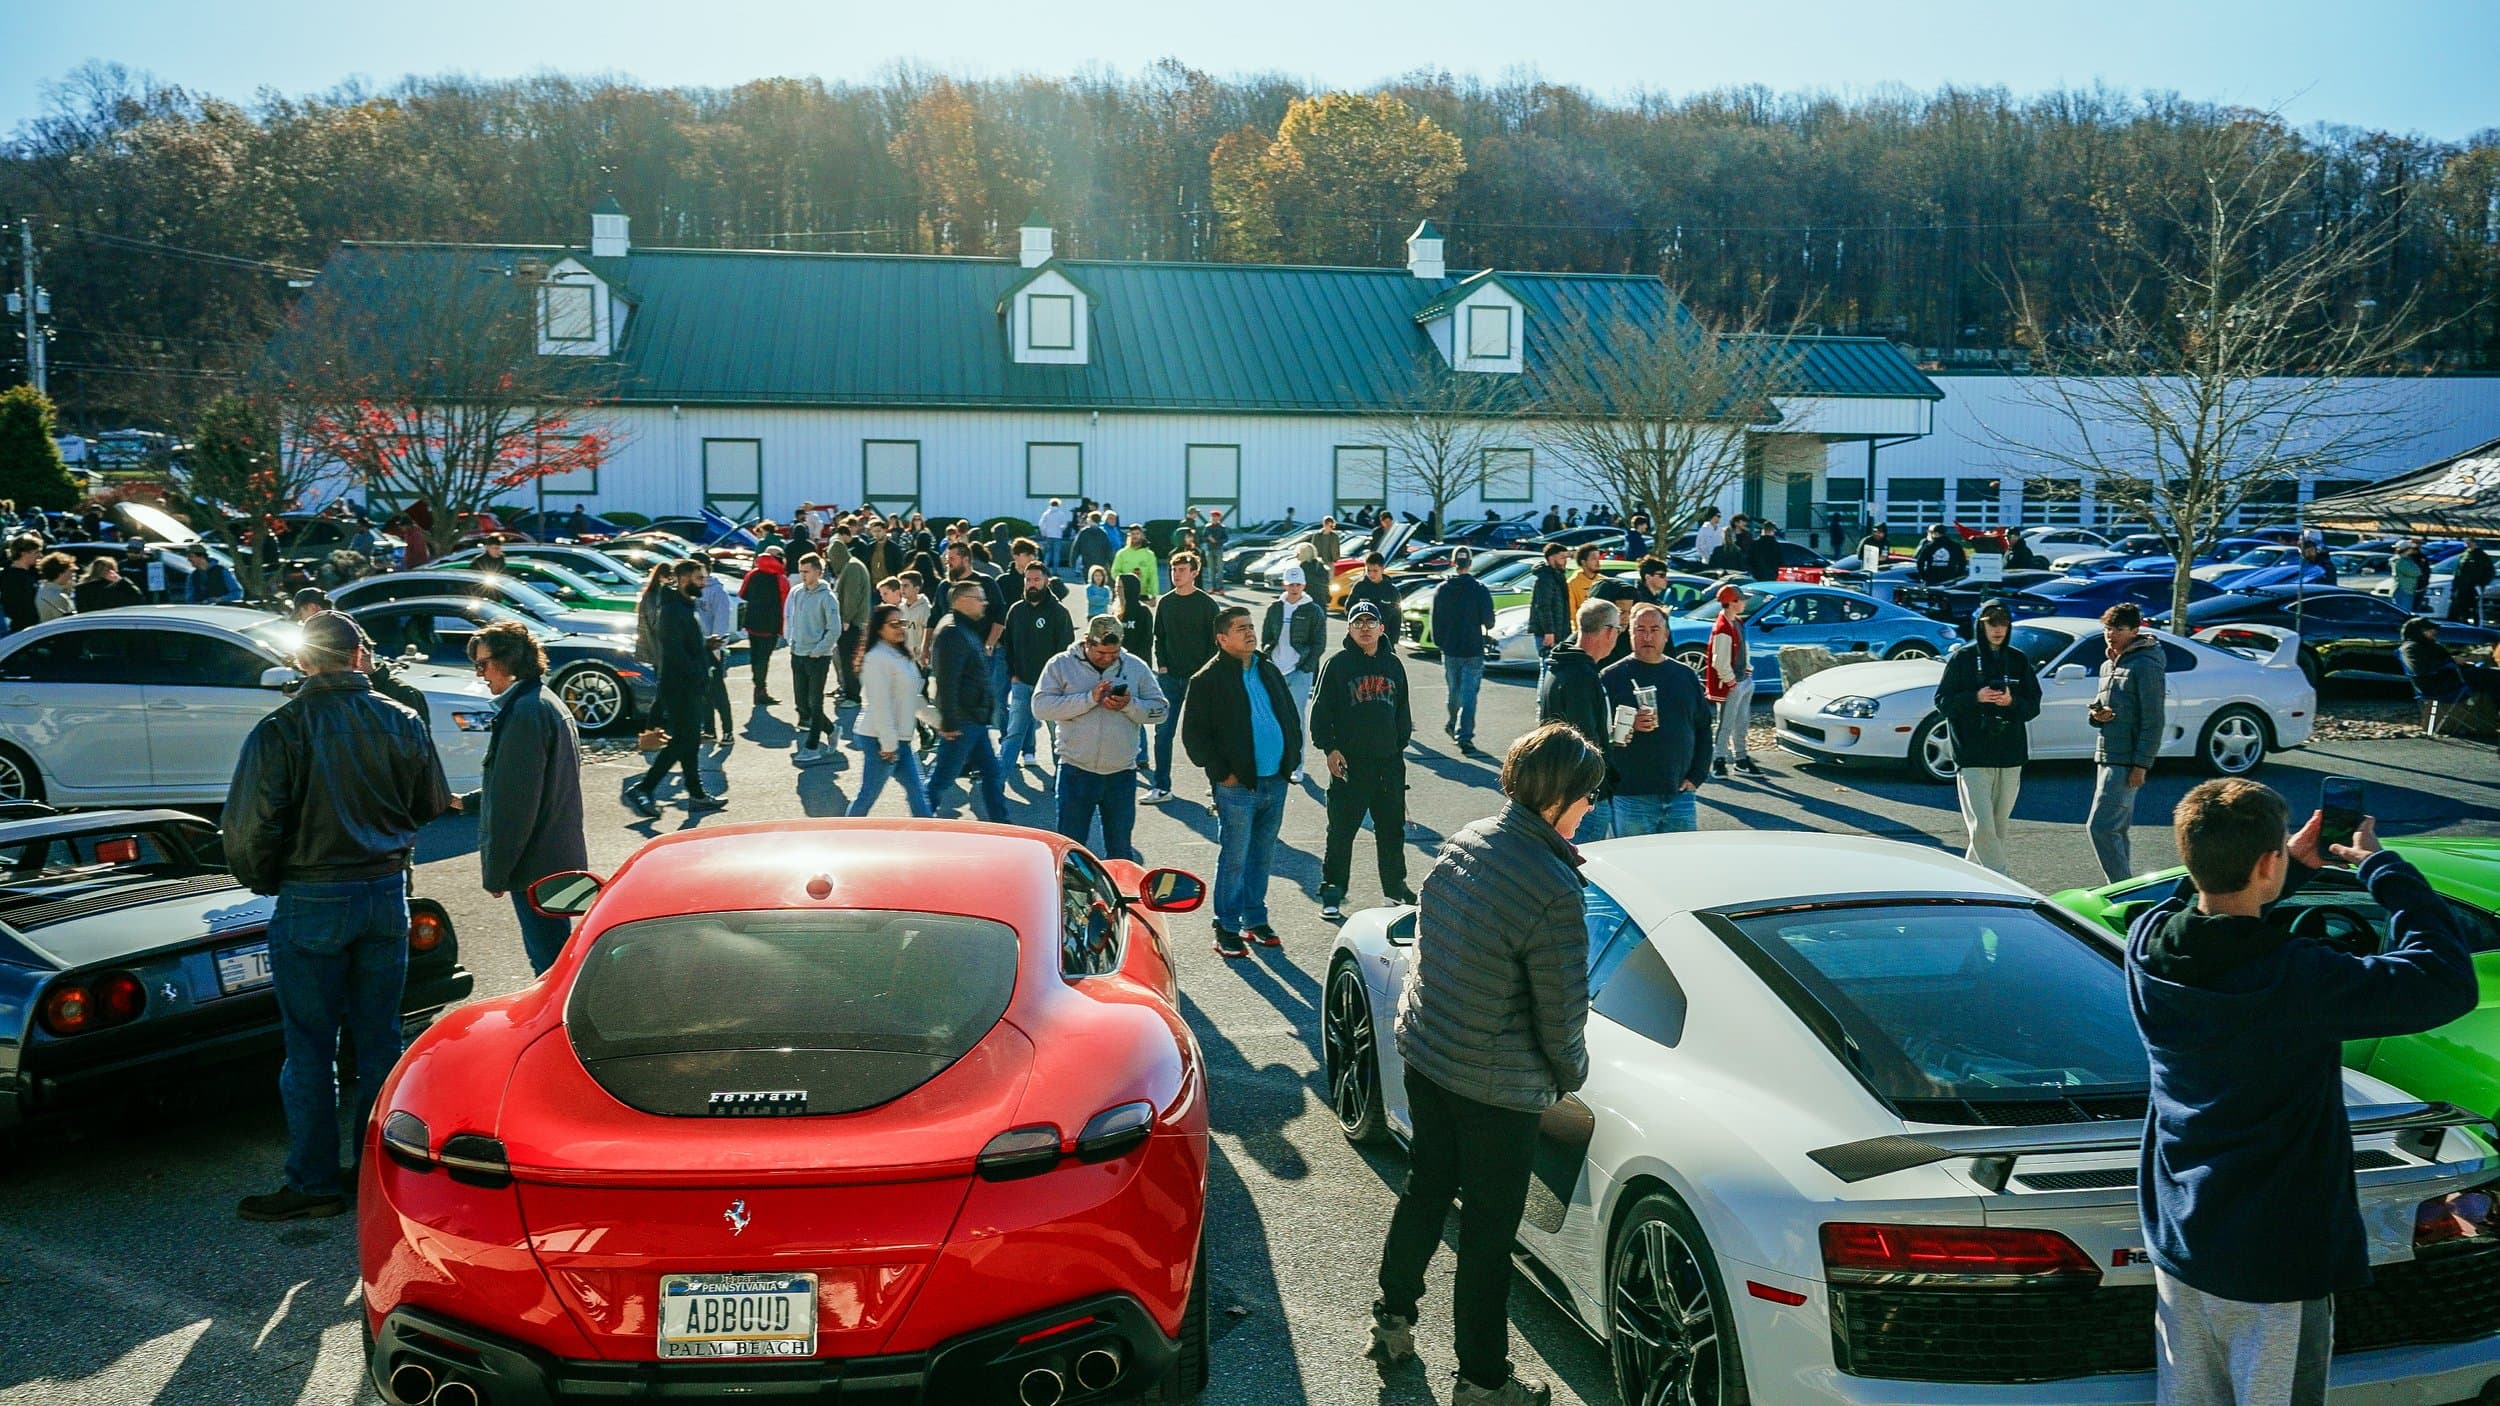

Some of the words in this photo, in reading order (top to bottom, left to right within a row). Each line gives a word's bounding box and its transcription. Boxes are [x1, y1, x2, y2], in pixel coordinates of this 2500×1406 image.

[708, 1090, 808, 1103] Ferrari
[701, 1281, 778, 1293] PENNSYLVANIA
[685, 1296, 790, 1334] ABBOUD
[669, 1342, 723, 1356] PALM
[735, 1341, 806, 1355] BEACH
